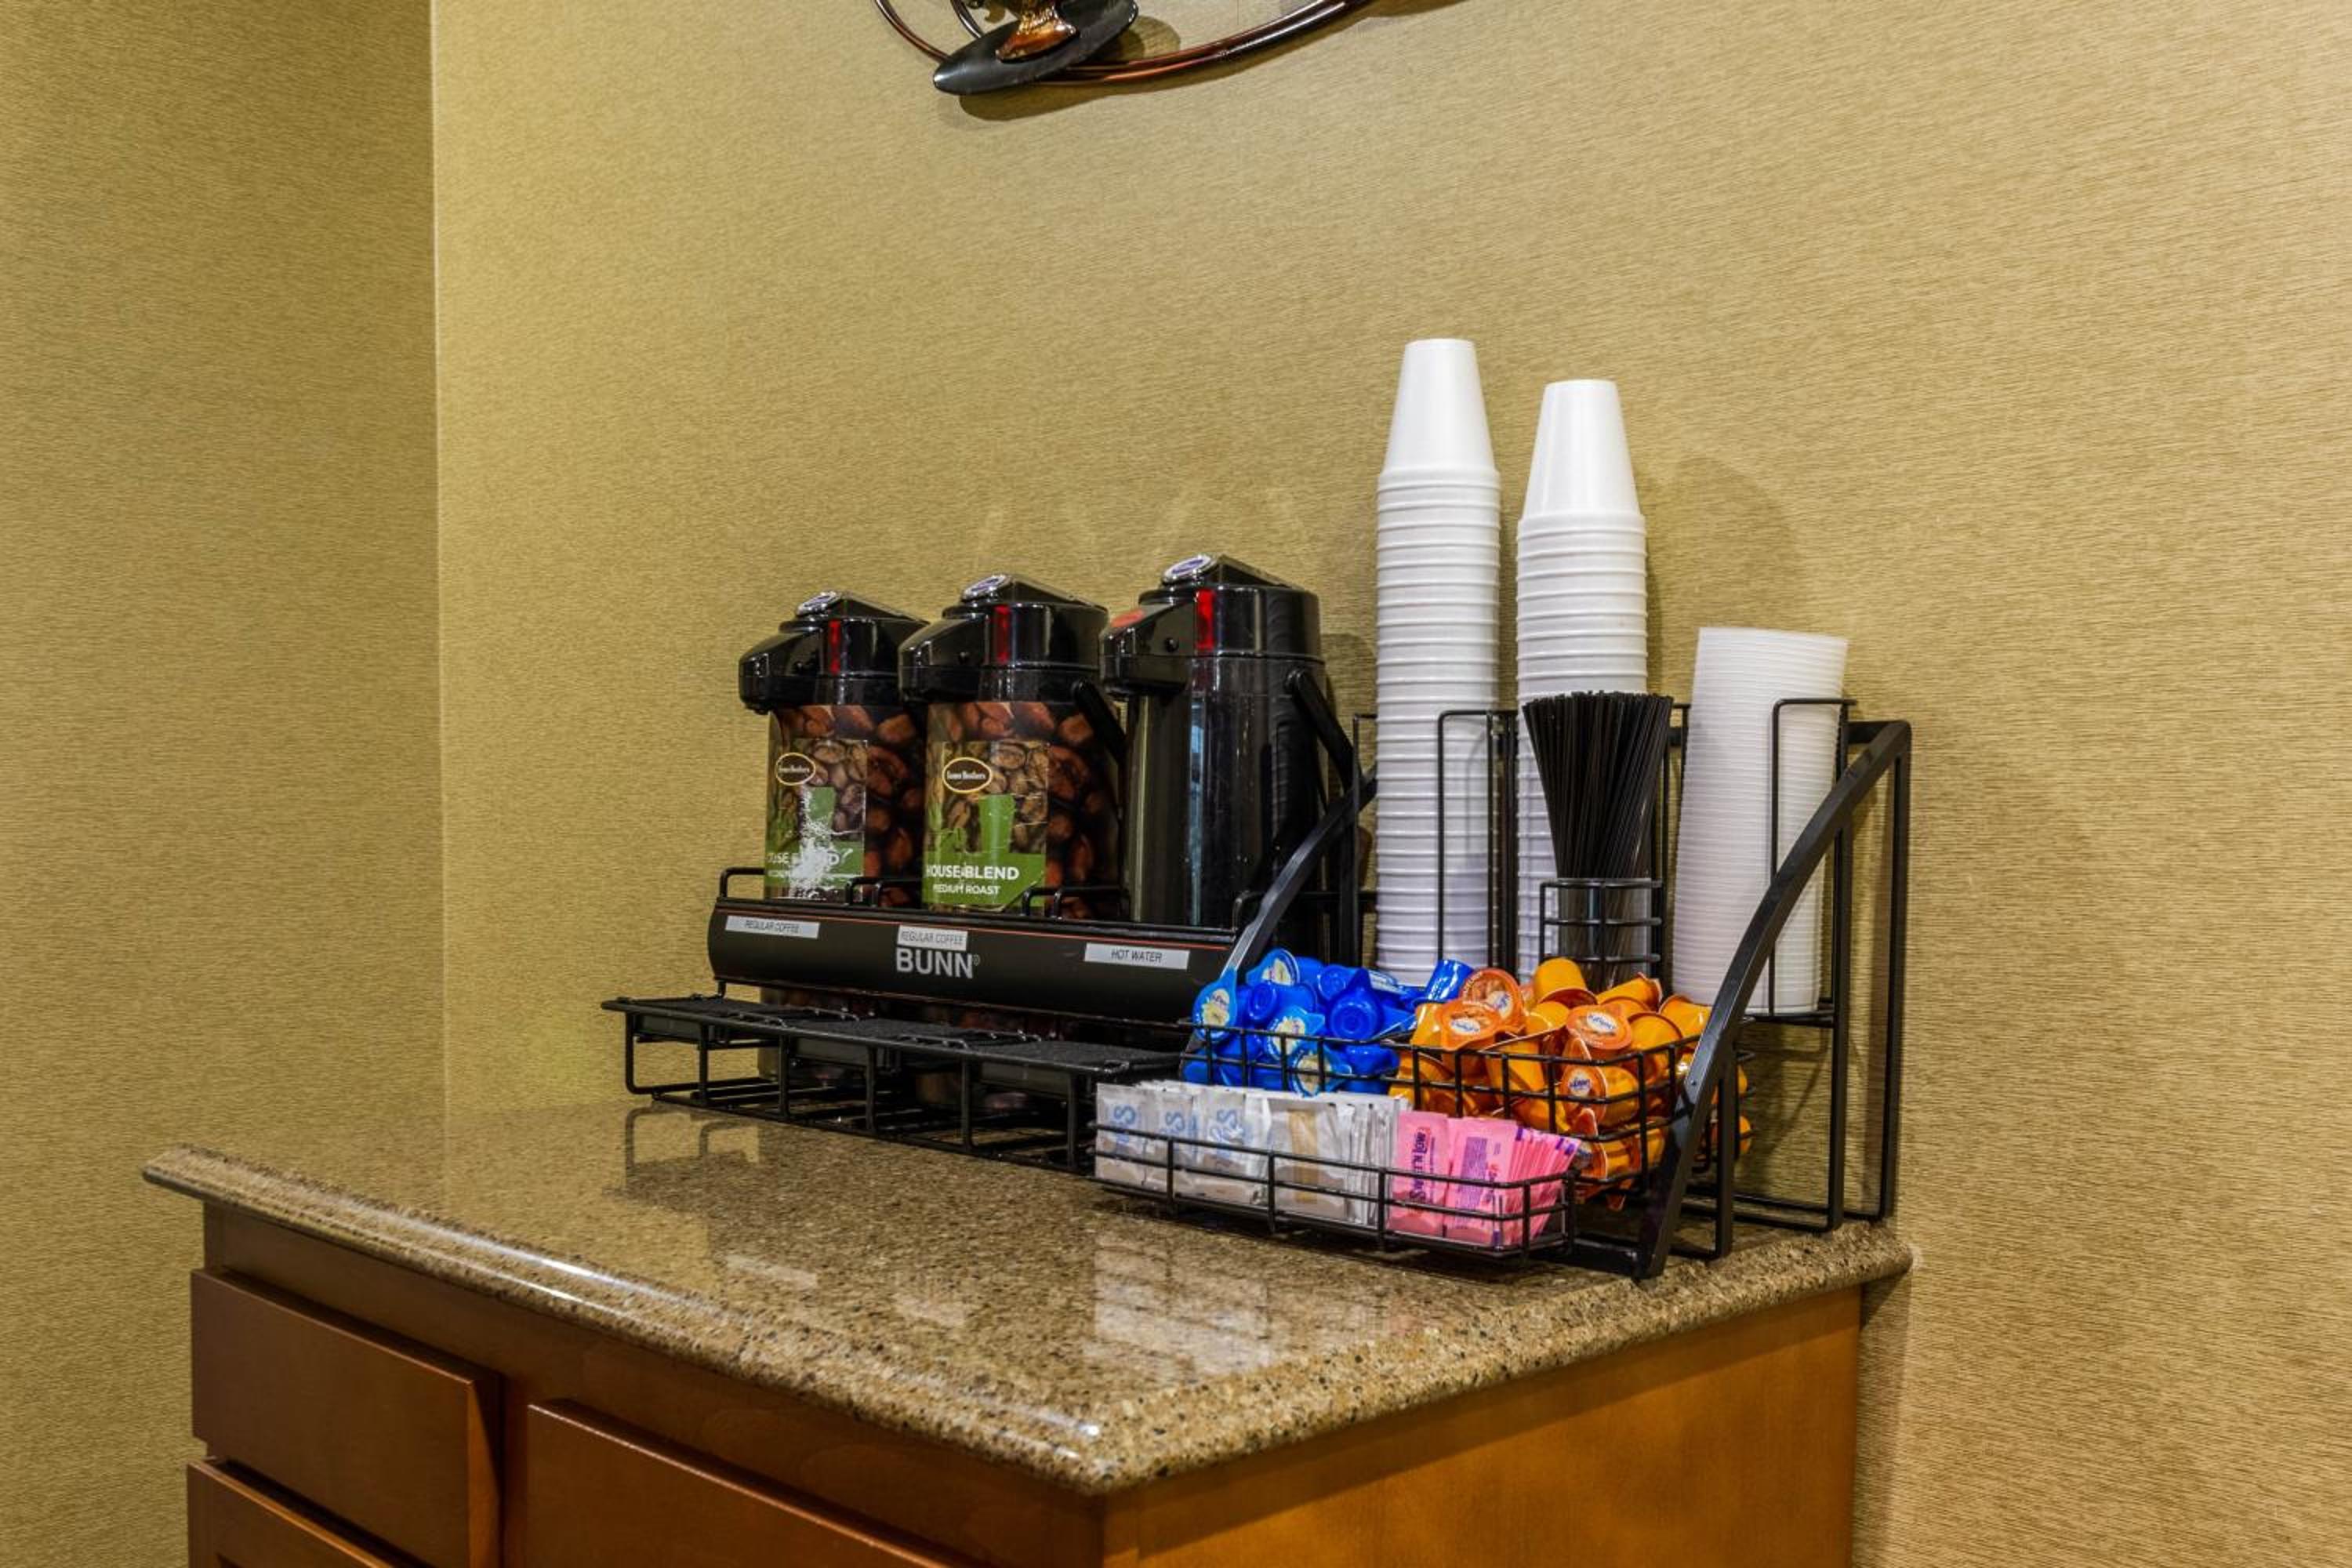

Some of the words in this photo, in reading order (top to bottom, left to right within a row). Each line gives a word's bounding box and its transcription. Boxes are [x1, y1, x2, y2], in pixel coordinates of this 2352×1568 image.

[965, 866, 1019, 880] BLEND
[965, 885, 1000, 895] ROAST
[745, 920, 775, 931] REGULAR
[775, 923, 800, 933] COFFEE
[901, 930, 934, 942] REGULAR
[935, 933, 964, 946] COFFEE
[895, 947, 974, 979] BUNN
[1111, 949, 1130, 960] HOT
[1131, 949, 1163, 964] WATER
